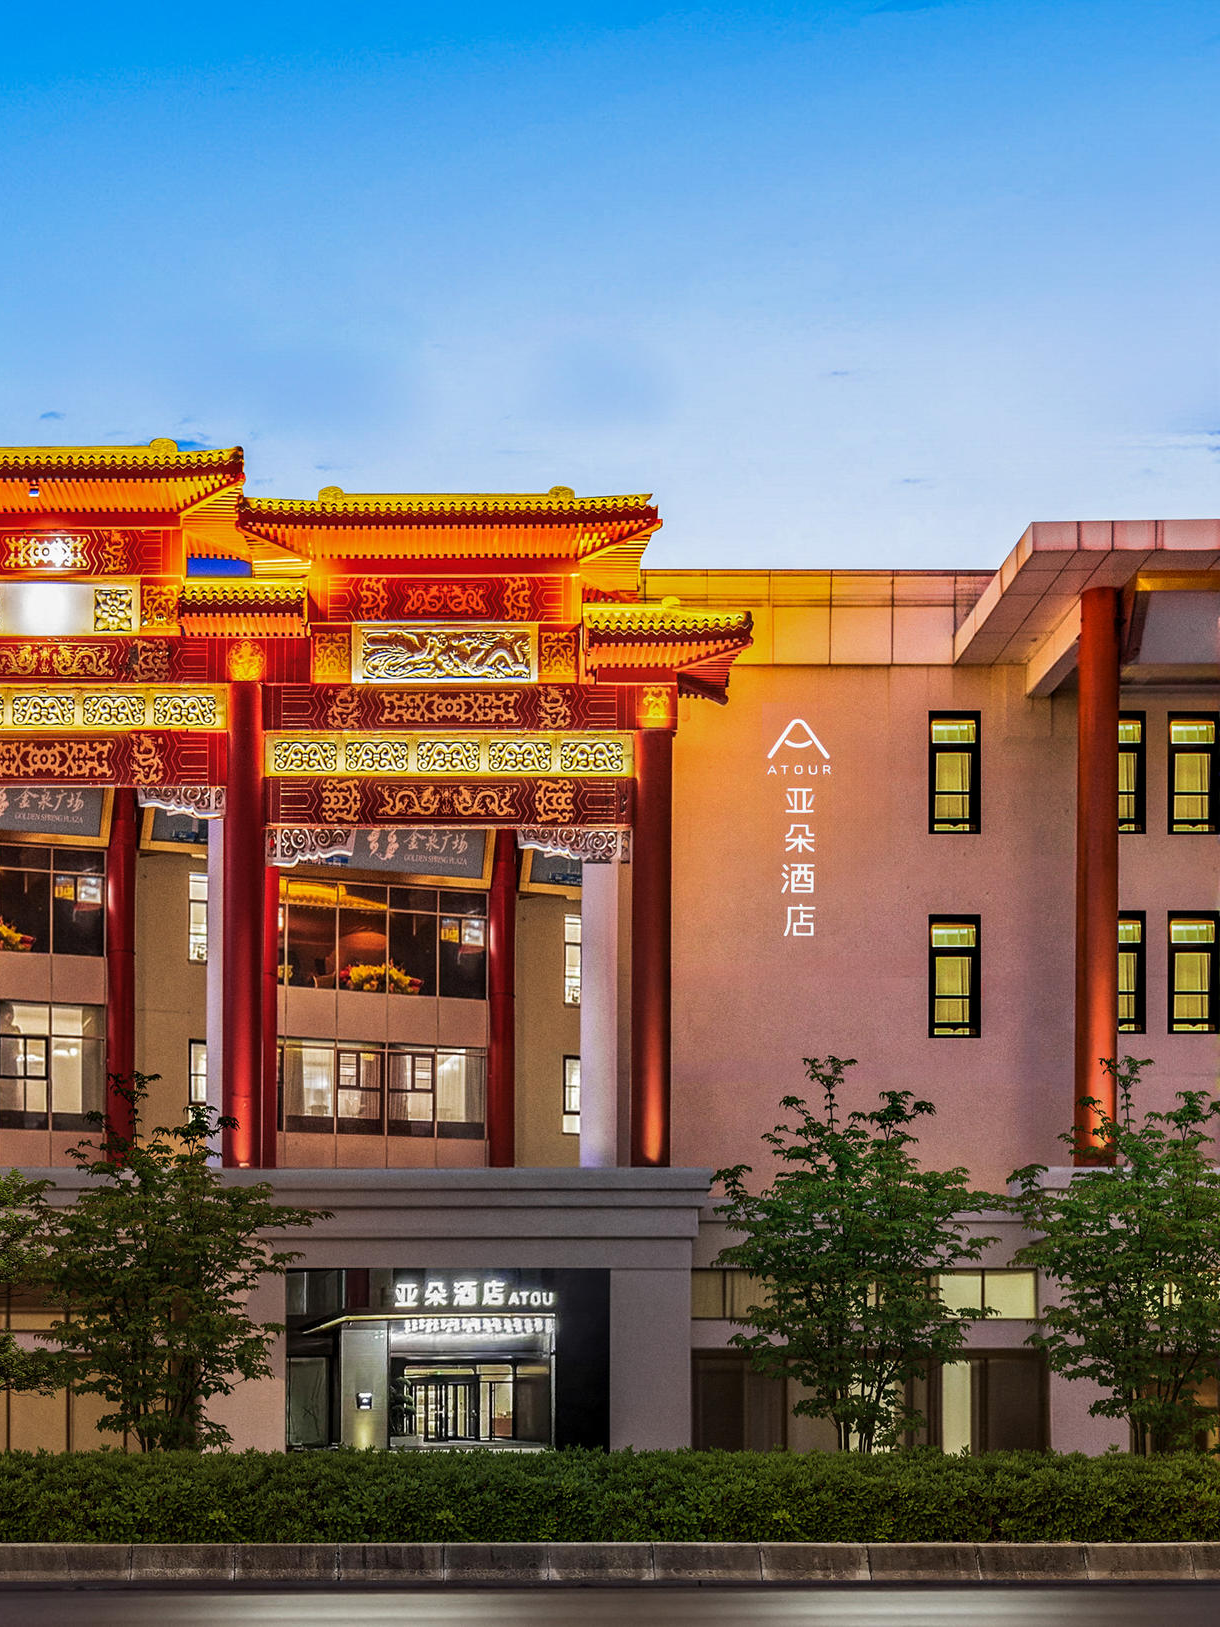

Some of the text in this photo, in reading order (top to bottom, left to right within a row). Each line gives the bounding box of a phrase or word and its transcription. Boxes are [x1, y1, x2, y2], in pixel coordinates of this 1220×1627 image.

[767, 764, 831, 775] ATOUR
[14, 788, 85, 813] 金泉广场
[15, 812, 84, 824] GOLDEN SPRING PLAZA
[403, 829, 469, 854] 金泉广场
[404, 854, 468, 866] GOLDEN SPRING PLAZA
[781, 787, 816, 937] 亚朵酒店
[394, 1280, 506, 1307] 亚朵酒店
